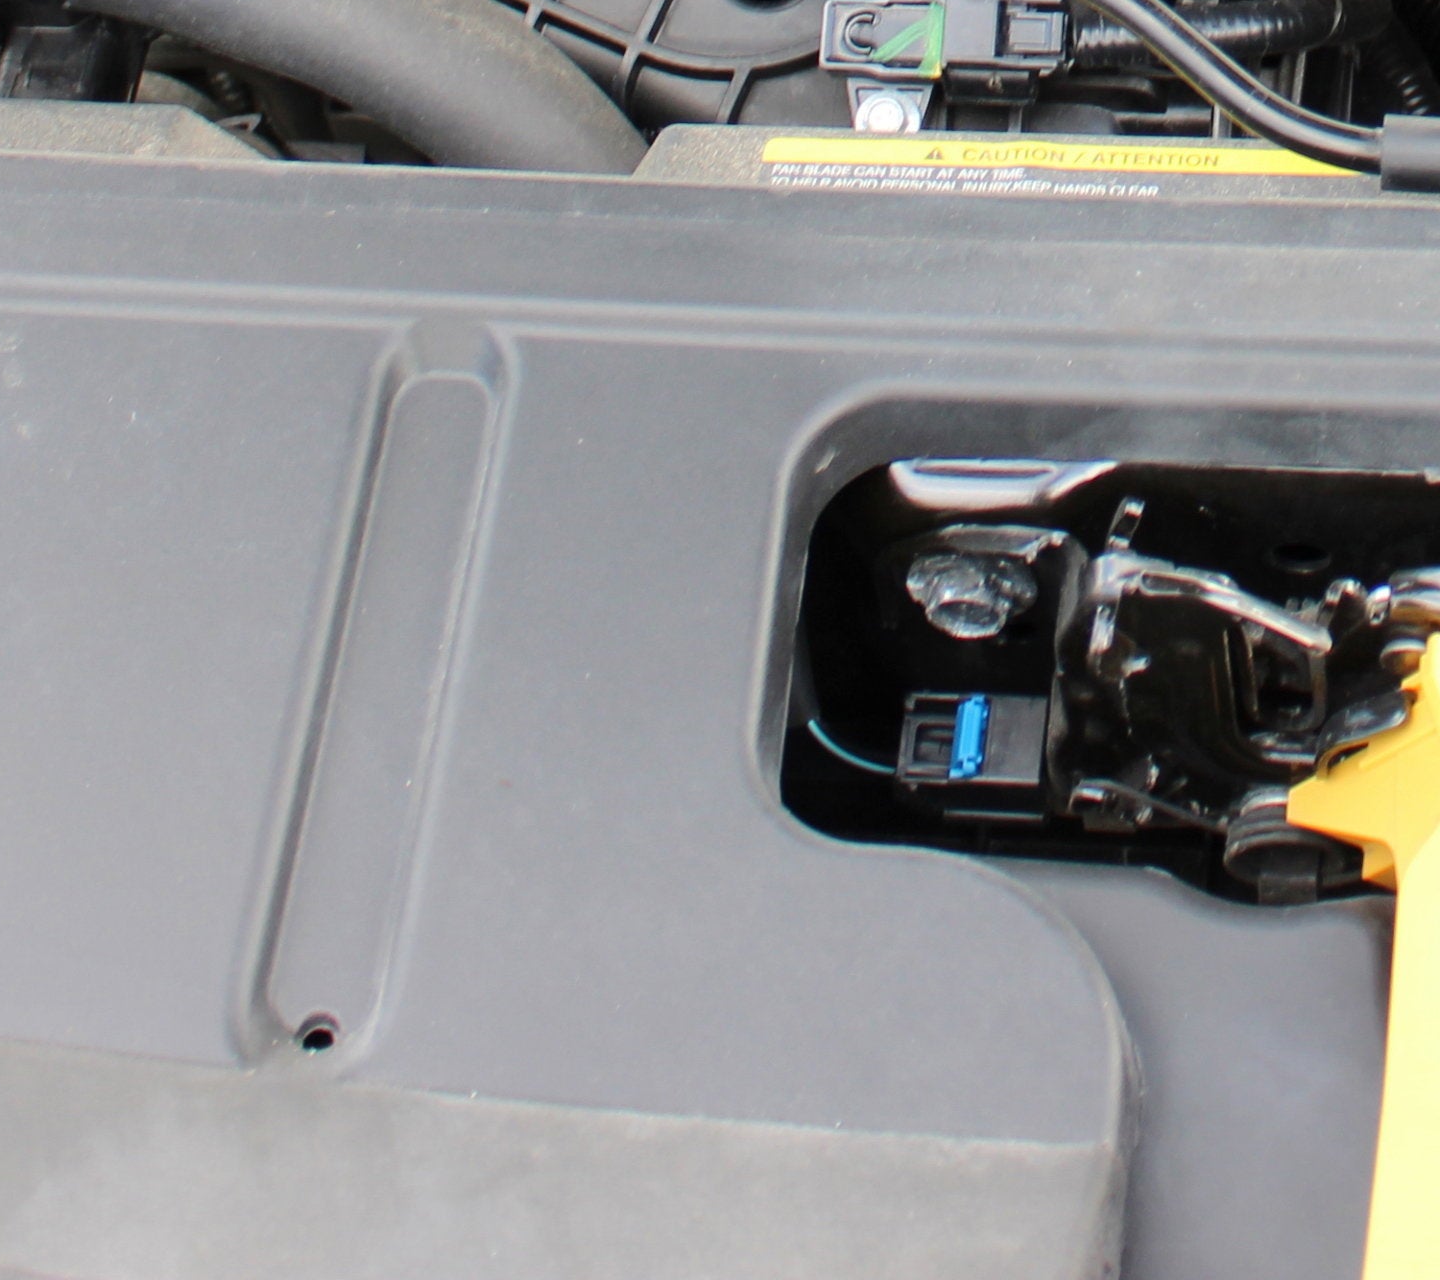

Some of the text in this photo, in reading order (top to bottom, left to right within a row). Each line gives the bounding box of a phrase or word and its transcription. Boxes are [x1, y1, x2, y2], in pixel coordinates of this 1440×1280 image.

[962, 147, 1065, 163] CAUTION
[1092, 151, 1220, 168] ATTENTION
[802, 164, 852, 177] BLADE
[853, 165, 887, 178] CAN
[888, 166, 935, 179] START
[936, 167, 956, 180] AT
[958, 168, 989, 181] ANY
